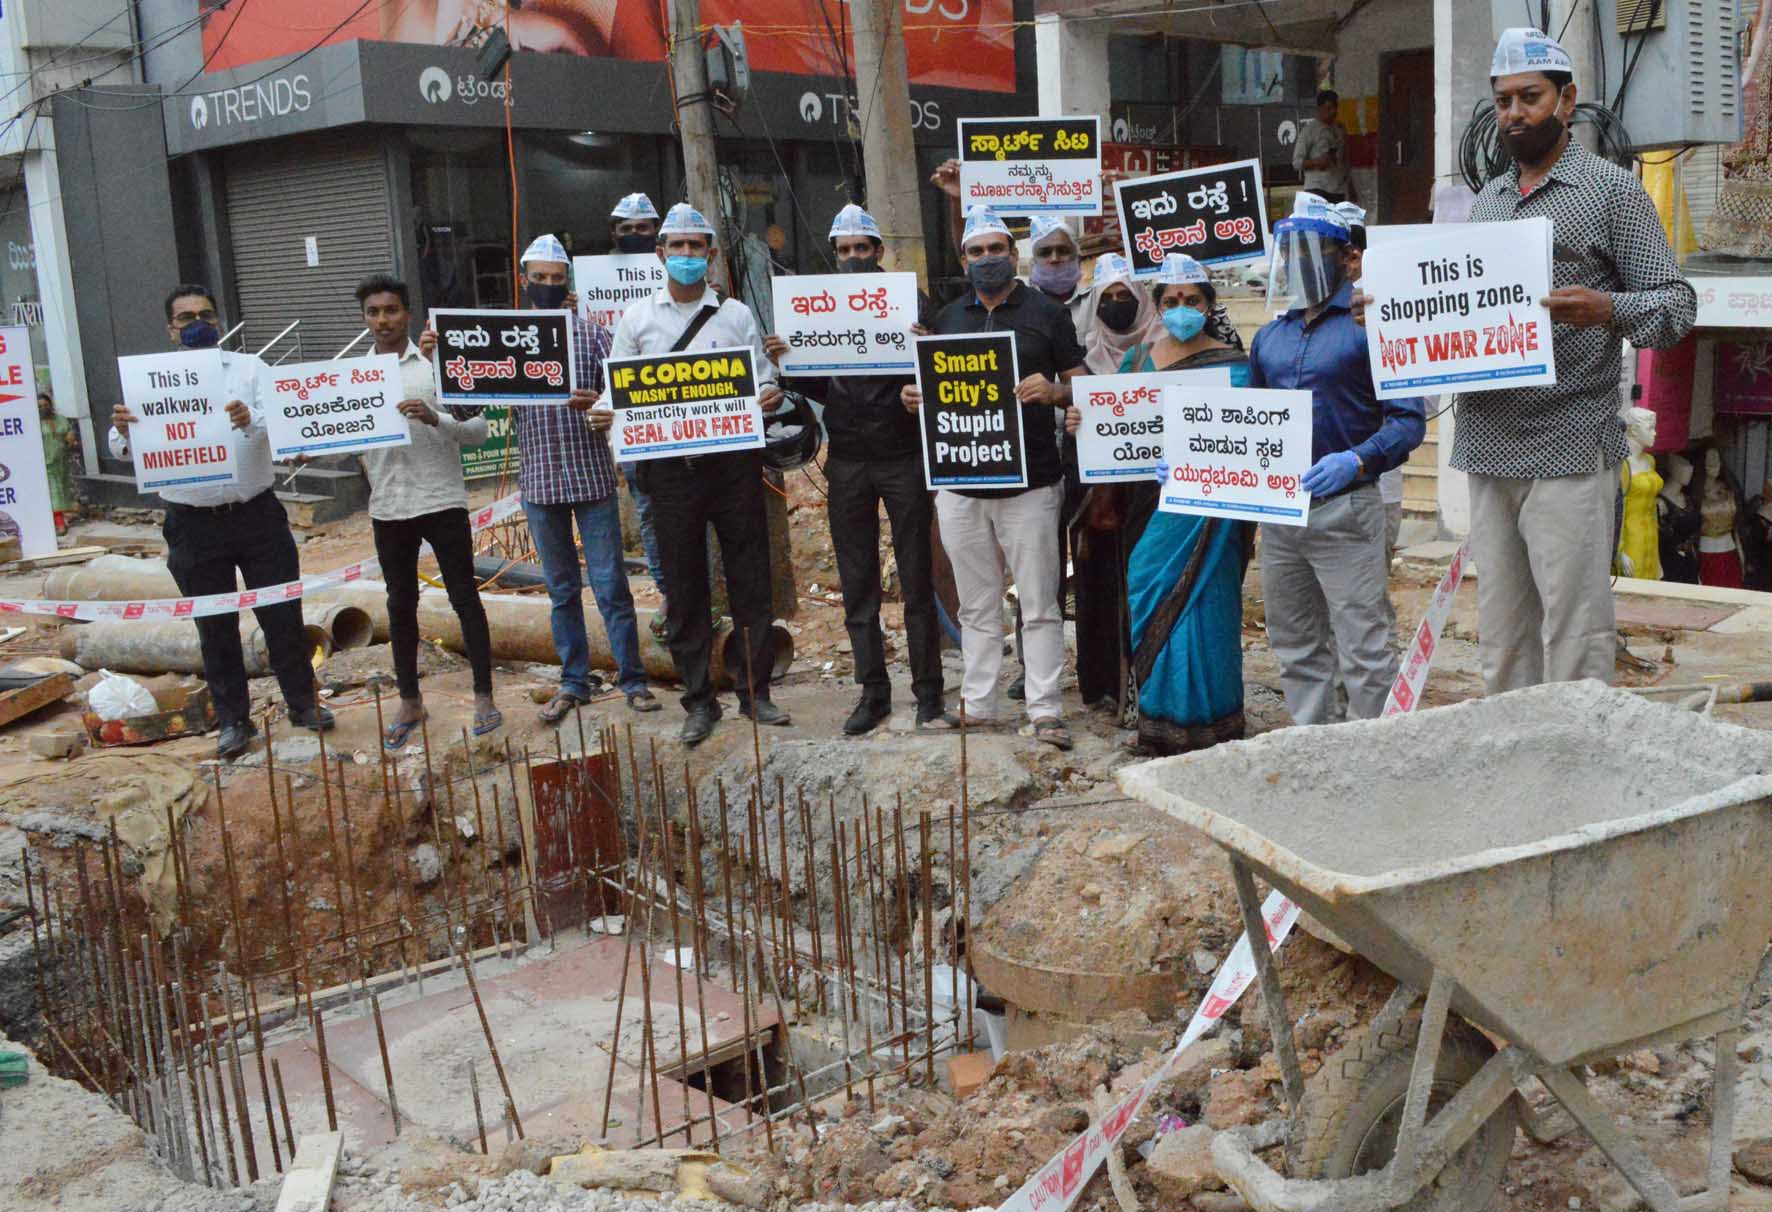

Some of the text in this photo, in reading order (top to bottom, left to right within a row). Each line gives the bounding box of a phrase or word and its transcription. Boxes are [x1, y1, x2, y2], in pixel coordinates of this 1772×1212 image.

[207, 74, 312, 127] TRENDS
[1054, 129, 1089, 150] ಸಿಟಿ
[1131, 190, 1177, 220] ಇದು
[1186, 181, 1230, 214] ರಸ್ತೆ
[1215, 217, 1257, 245] ಅಲ್ಲ
[616, 266, 663, 281] This is
[1418, 254, 1484, 285] This is
[791, 289, 836, 316] ಇದು
[1380, 283, 1532, 323] shopping zone,
[445, 324, 490, 349] ಇದು
[501, 325, 540, 355] ರಸ್ತೆ
[789, 328, 906, 355] ಕೆಸರುಗದ್ದೆ ಅಲ್ಲ
[1378, 310, 1538, 375] NOT WAR ZONE
[524, 360, 564, 386] ಅಲ್ಲ
[613, 358, 747, 389] IF CORONA
[933, 350, 998, 374] Smart
[148, 369, 199, 389] This is
[142, 397, 213, 416] walkway,
[283, 392, 385, 418] ಲೂಟಿಕೋರ
[629, 382, 739, 404] WASN'T ENOUGH,
[938, 379, 999, 407] City's
[625, 399, 746, 422] SmartCity work will
[937, 409, 1005, 437] Stupid
[1183, 403, 1290, 426] ಇದು ಶಾಪಿಂಗ್
[165, 421, 197, 441] NOT
[301, 414, 375, 439] ಯೋಜನೆ
[623, 422, 668, 446] SEAL
[672, 418, 708, 441] OUR
[711, 414, 754, 437] FATE
[142, 445, 228, 470] MINEFIELD
[935, 440, 1012, 467] Project
[1189, 433, 1283, 470] ಮಾಡುವ ಸ್ಥಳ
[1173, 463, 1258, 496] ಯುದ್ಧಭೂಮಿ
